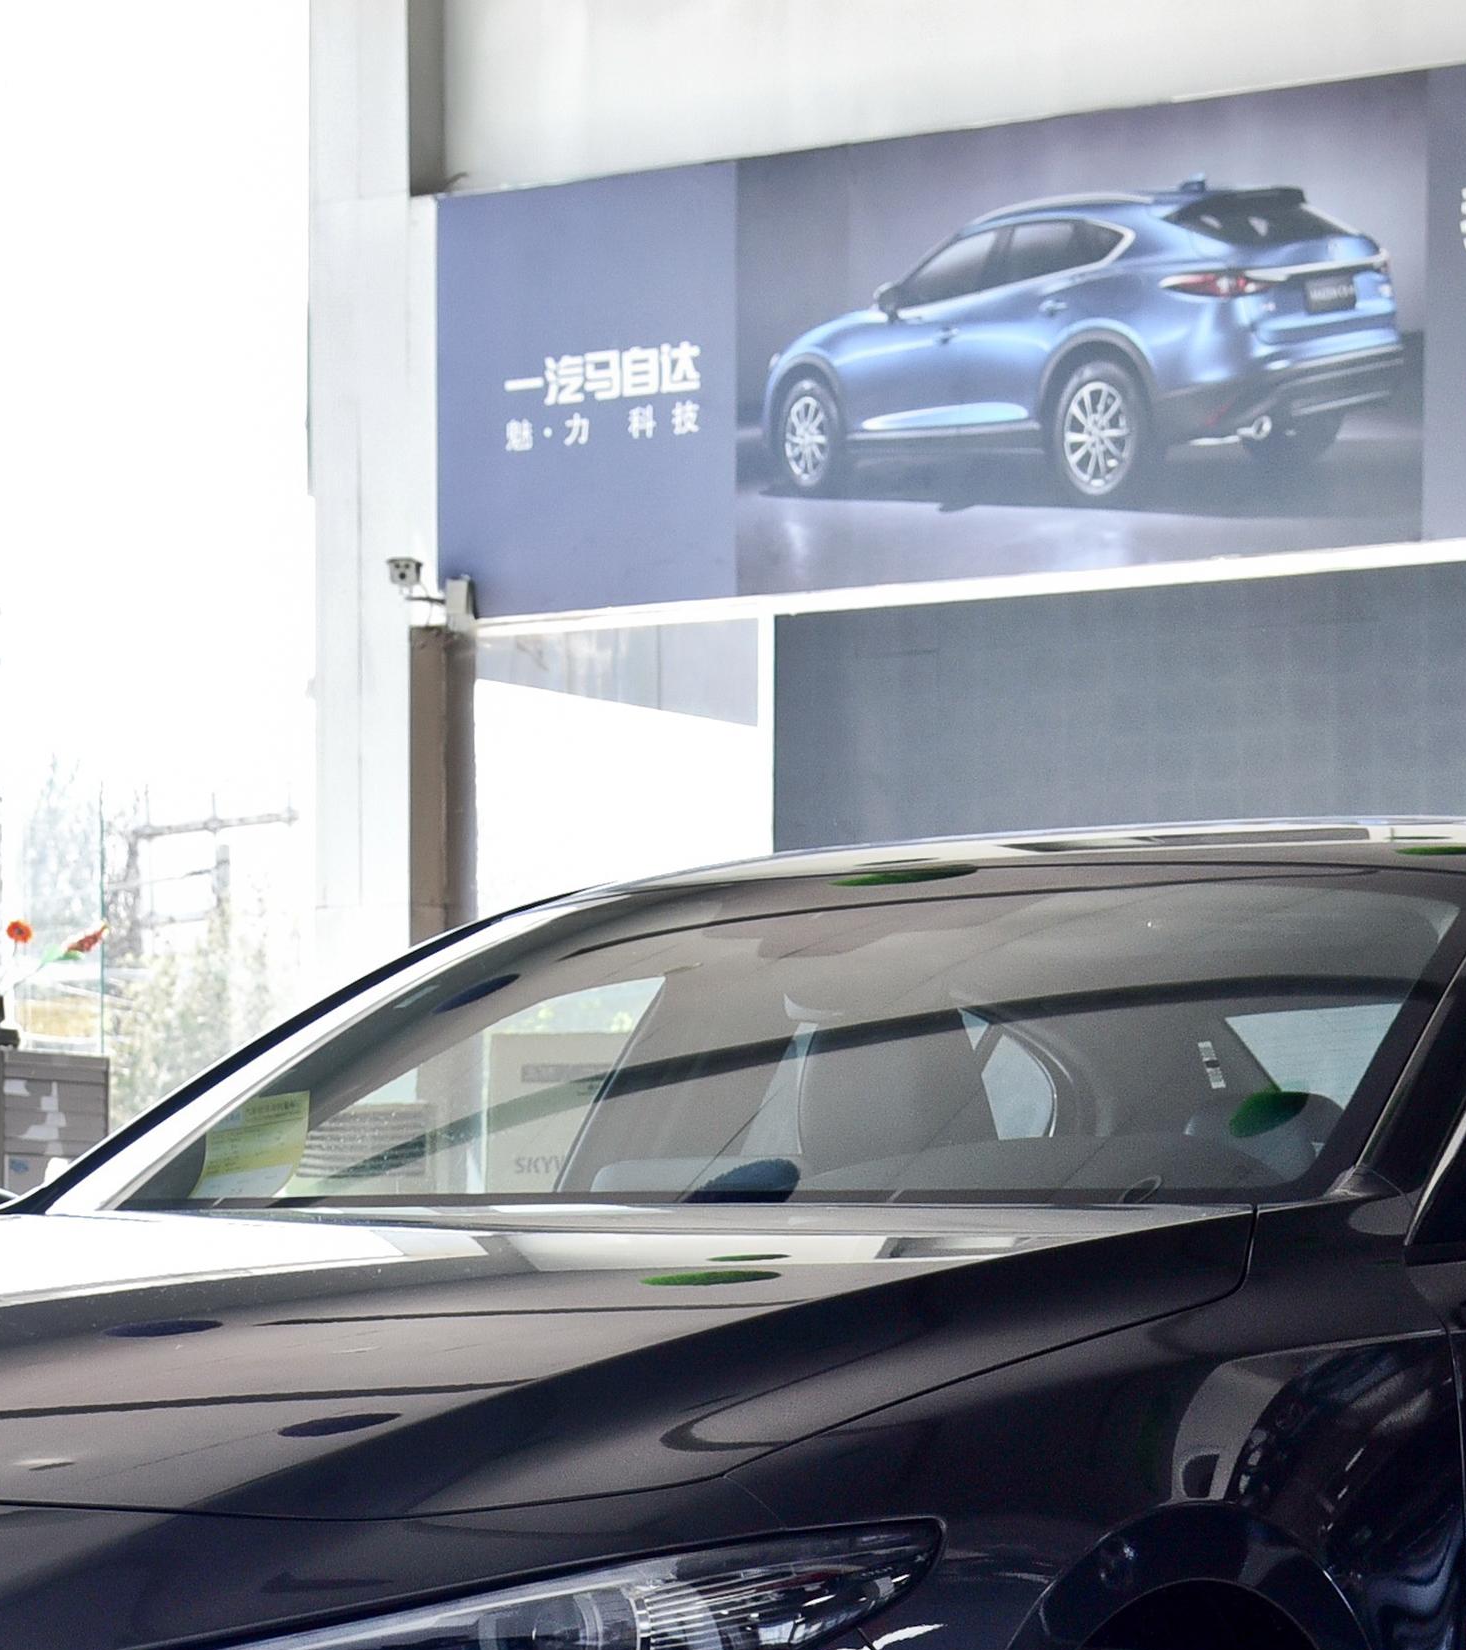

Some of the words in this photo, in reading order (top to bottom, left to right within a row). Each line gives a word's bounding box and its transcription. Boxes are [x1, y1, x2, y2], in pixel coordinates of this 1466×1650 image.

[504, 340, 701, 406] 一汽马自达
